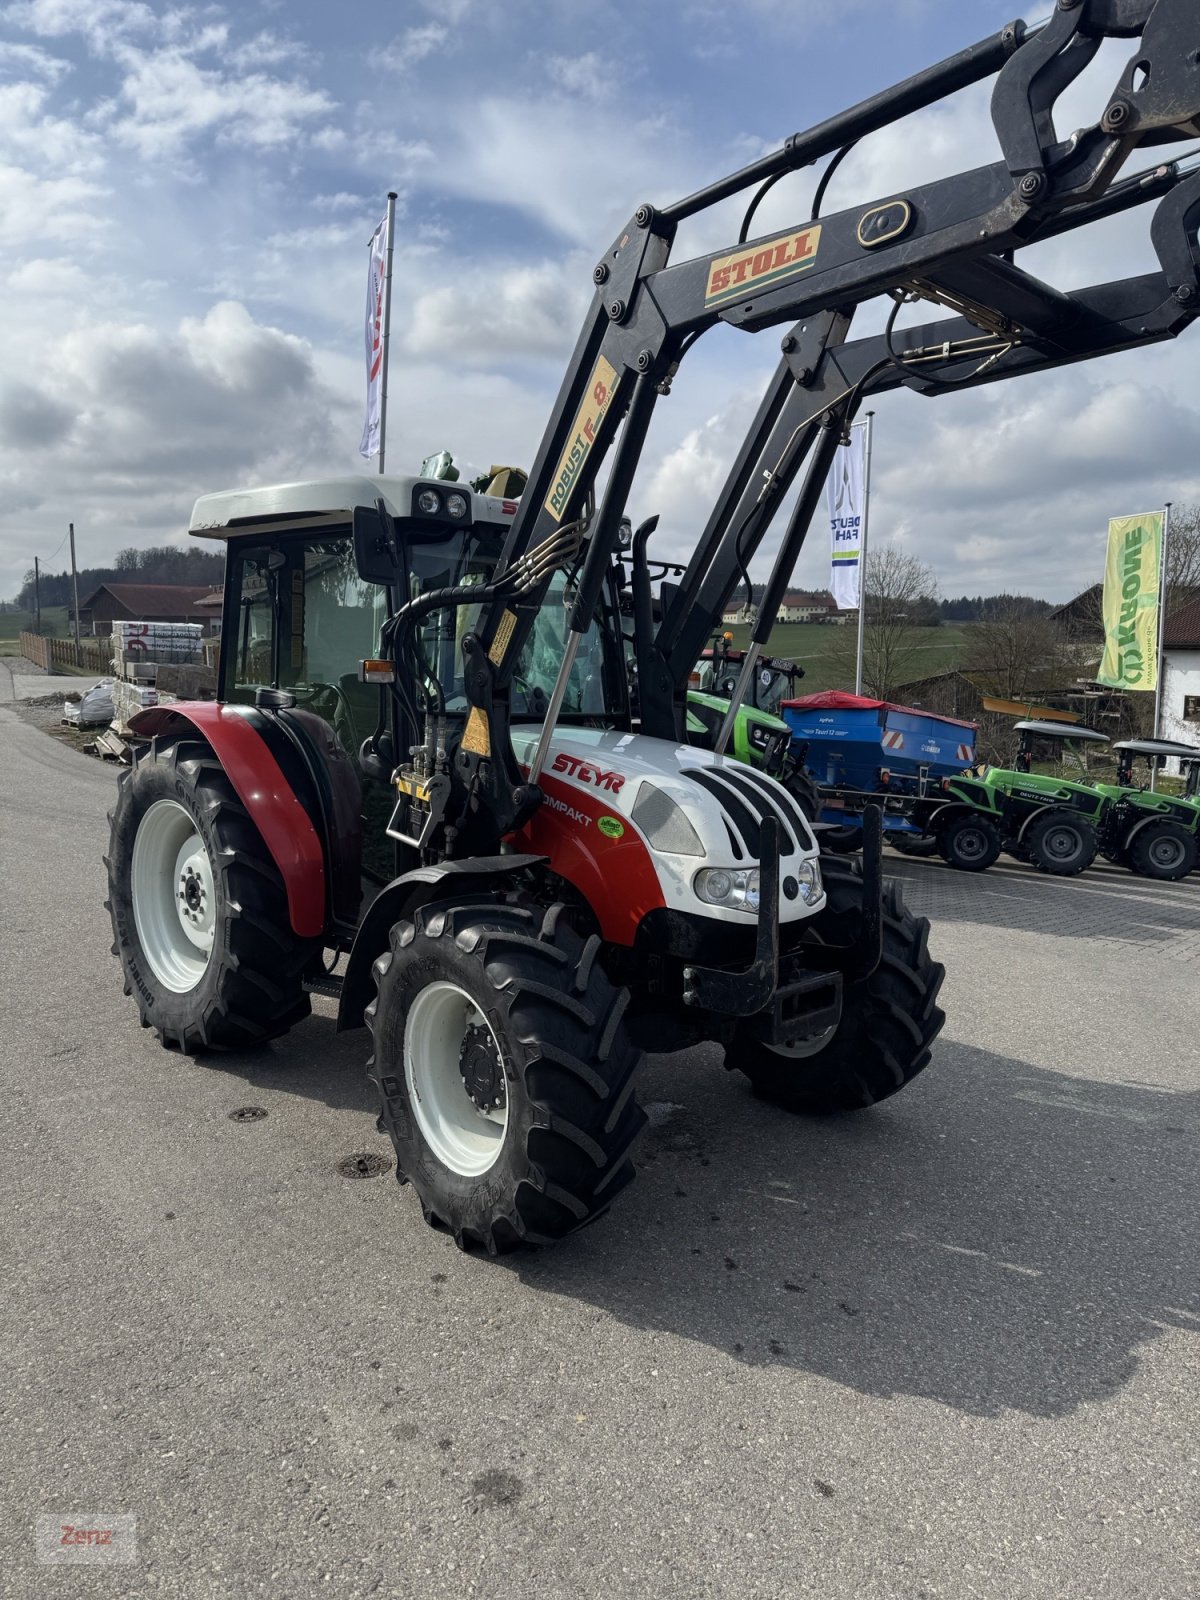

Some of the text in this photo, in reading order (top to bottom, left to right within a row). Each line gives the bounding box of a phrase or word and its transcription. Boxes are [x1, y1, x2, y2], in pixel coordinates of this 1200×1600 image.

[709, 232, 814, 294] STOLL
[550, 380, 607, 511] ROBUST F 8
[762, 671, 770, 684] 40
[551, 753, 626, 794] STEYR
